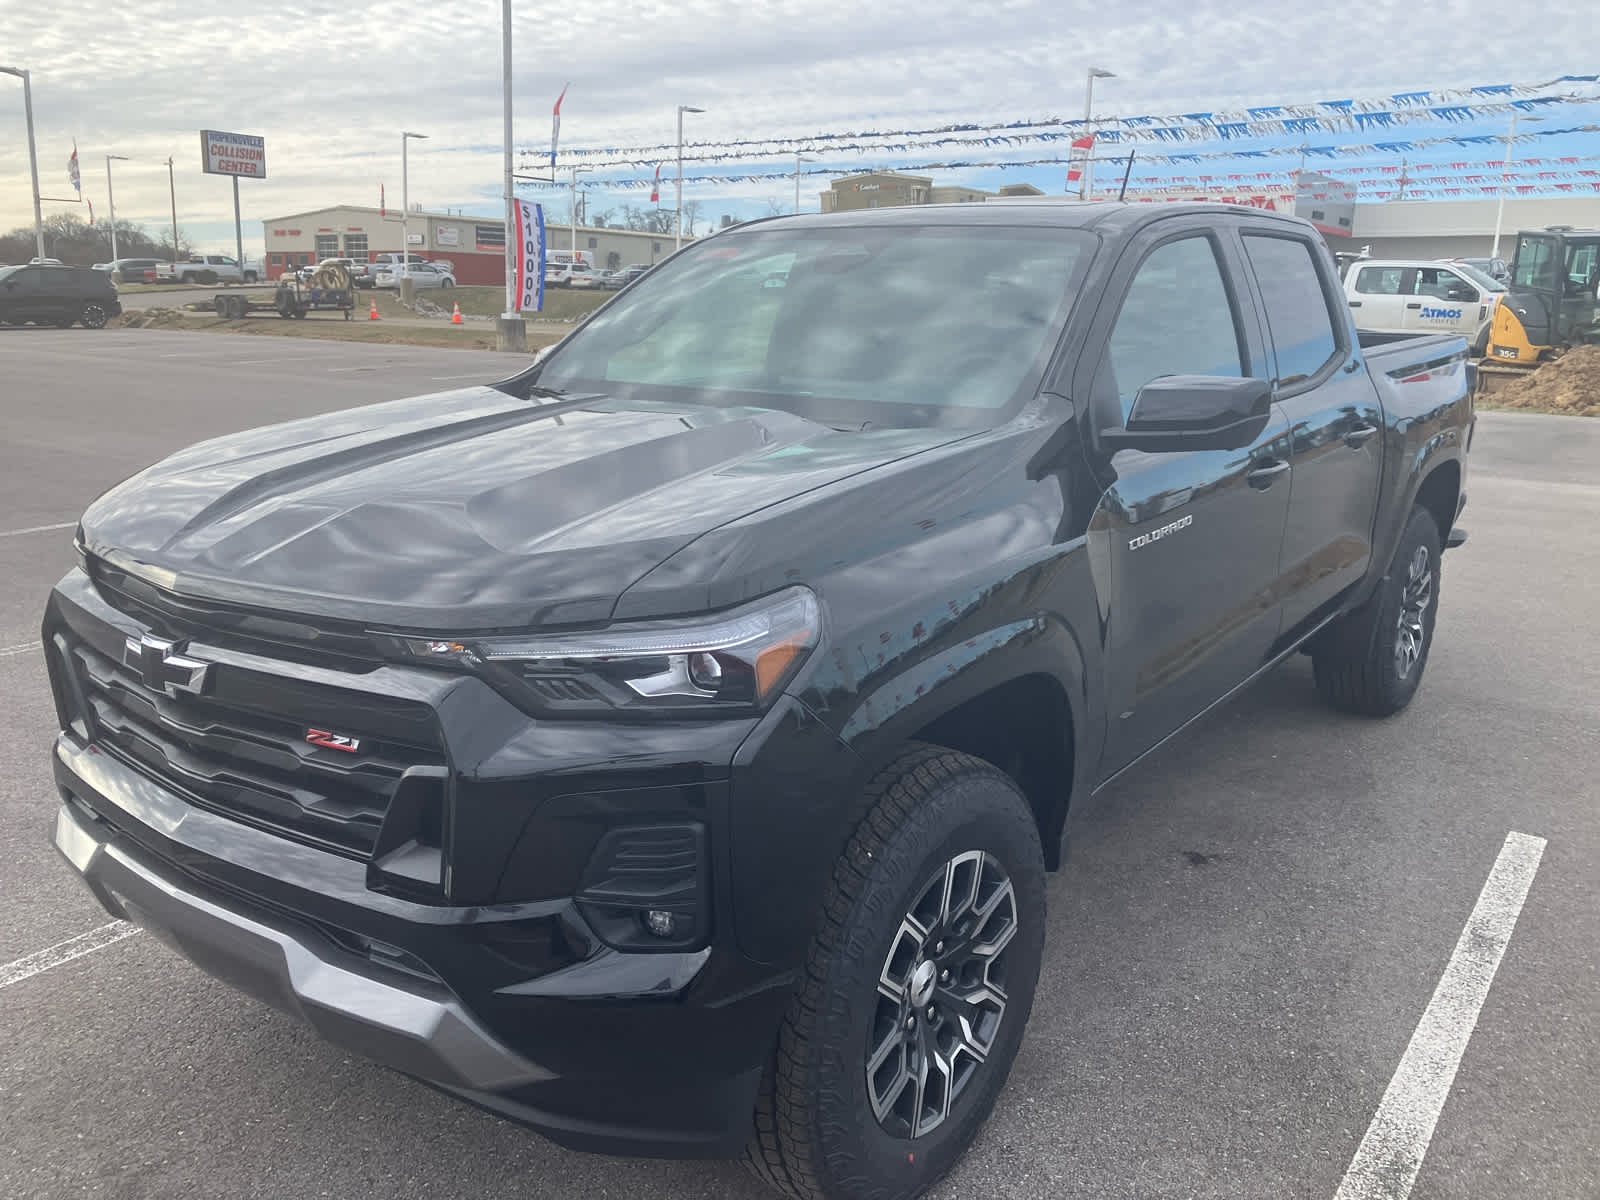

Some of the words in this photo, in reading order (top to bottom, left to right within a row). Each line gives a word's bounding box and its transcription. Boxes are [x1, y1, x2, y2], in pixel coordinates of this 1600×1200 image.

[211, 144, 262, 160] COLLISION
[218, 159, 256, 173] CENTER
[1419, 307, 1462, 319] ATMOS
[1128, 514, 1192, 550] COLORADO
[305, 728, 360, 752] Z71
